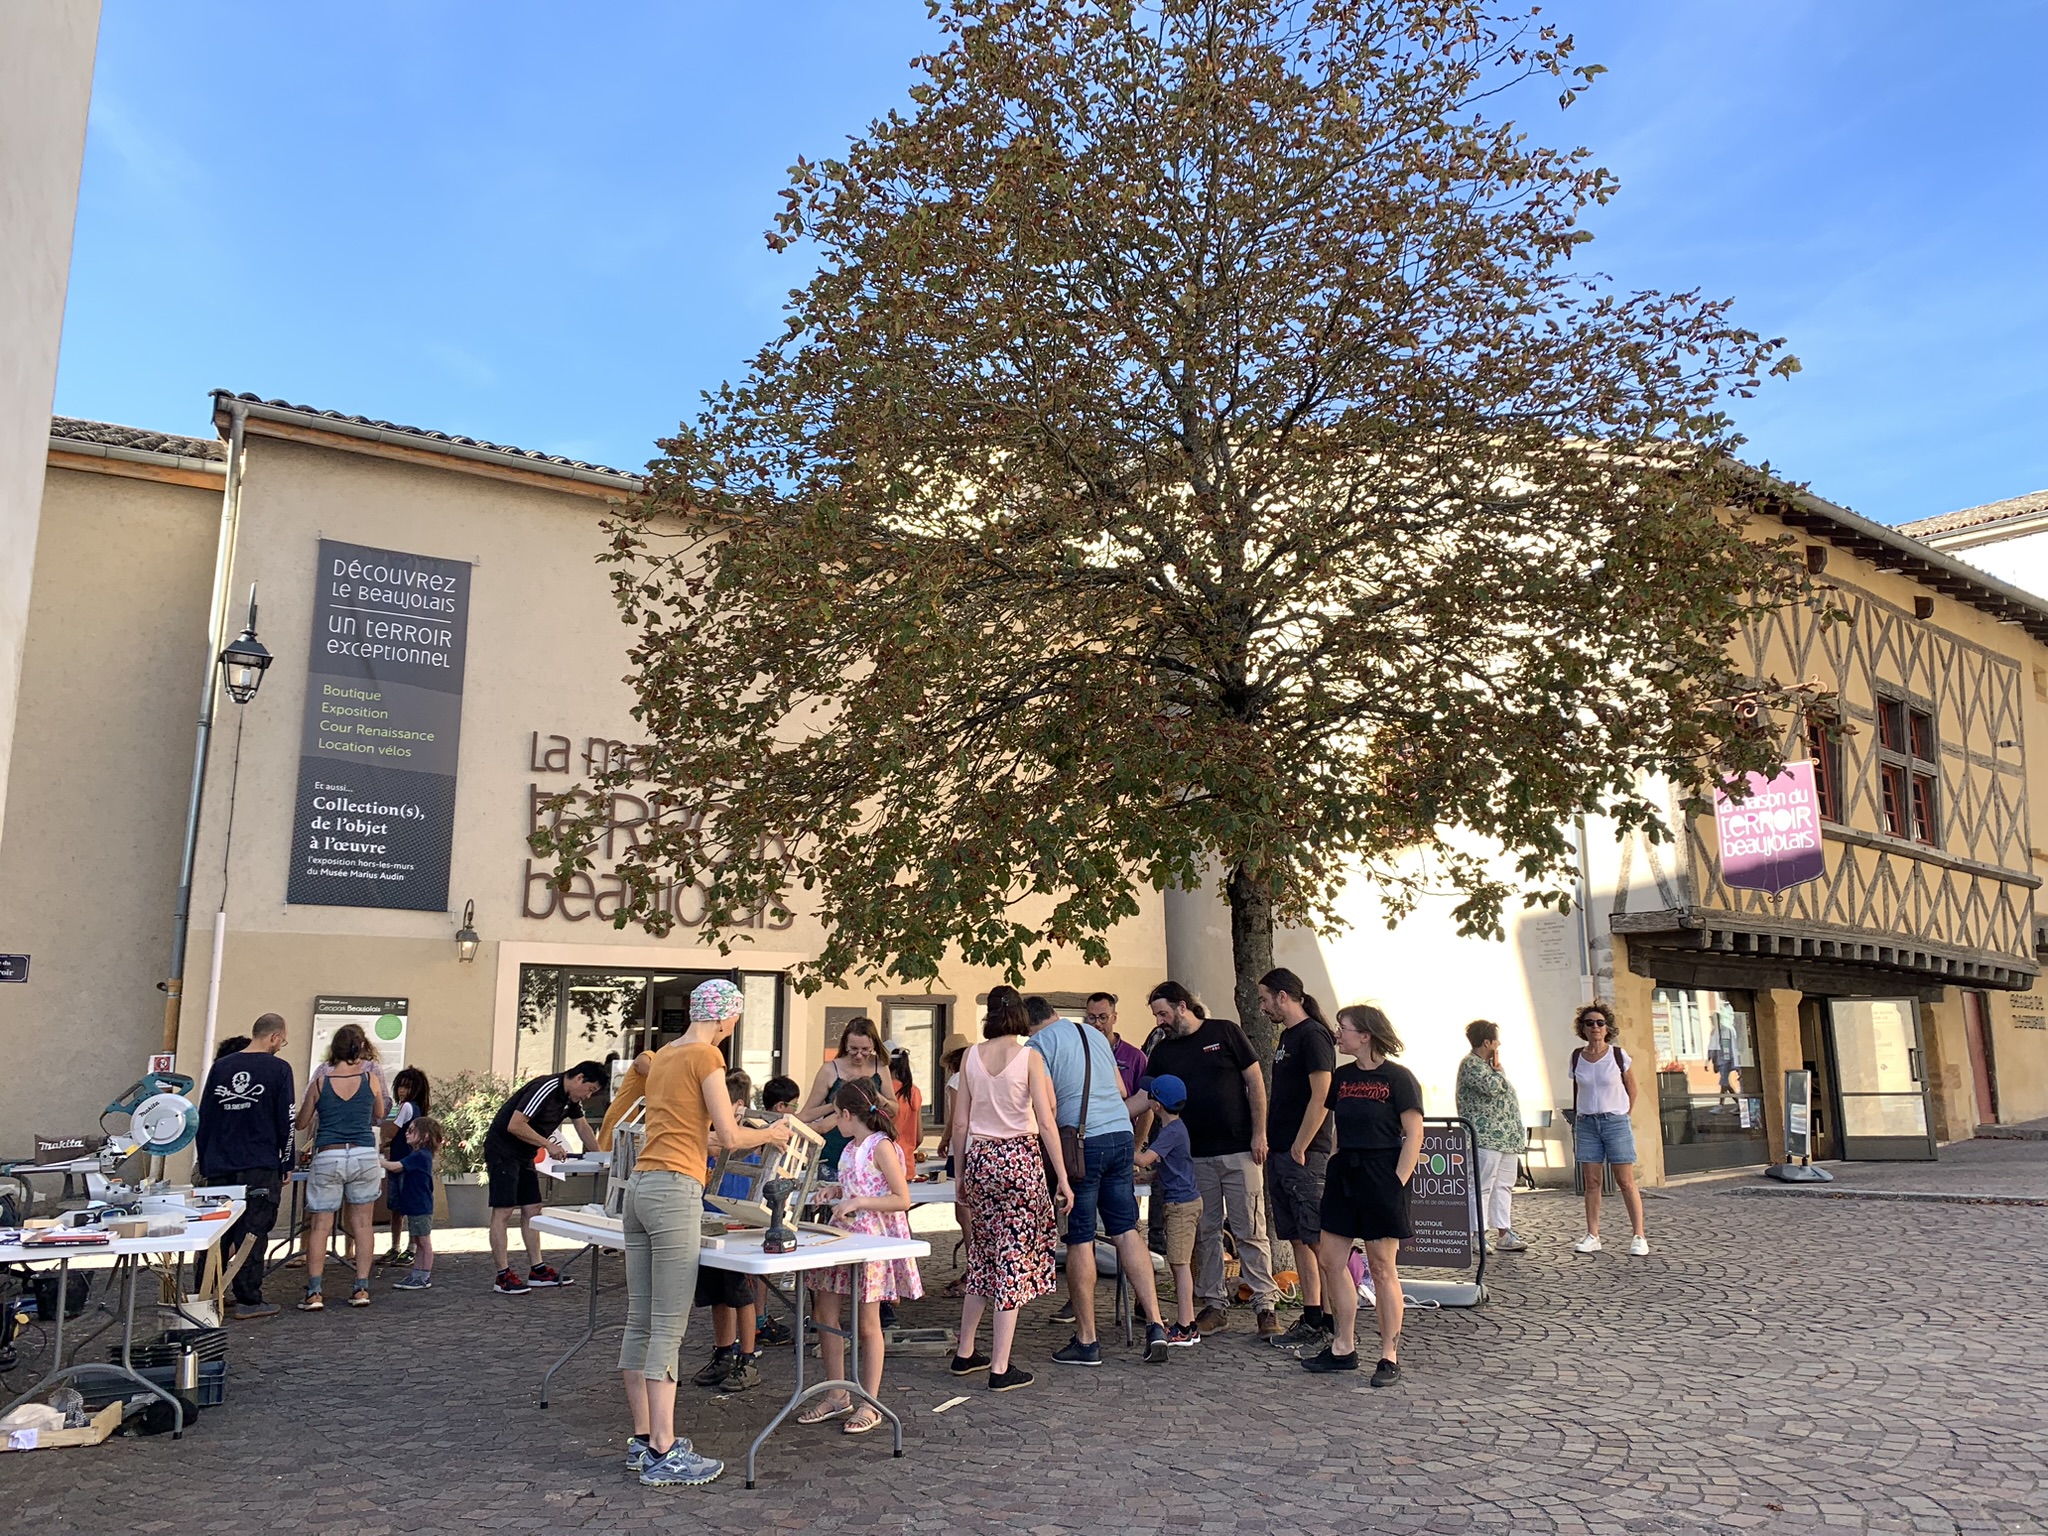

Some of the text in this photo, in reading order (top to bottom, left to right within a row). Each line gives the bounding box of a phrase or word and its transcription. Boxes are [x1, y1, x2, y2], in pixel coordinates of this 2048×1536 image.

[323, 684, 382, 702] Boutique
[321, 702, 388, 719] Exposition
[319, 720, 435, 741] Cour Renaissance
[318, 737, 412, 757] Location vélos
[314, 781, 323, 790] Et
[1788, 788, 1809, 804] du
[313, 796, 425, 820] Collection(s),
[311, 816, 388, 837] de l'objet
[309, 836, 386, 854] à l'œuvre
[308, 856, 414, 870] l'exposition hors-les-murs
[320, 868, 348, 877] Musée
[350, 870, 378, 879] Marius
[380, 871, 404, 881] Audin
[347, 1005, 381, 1013] Beaujolais
[1445, 1135, 1463, 1151] du
[1432, 1238, 1468, 1246] RENAISSANCE
